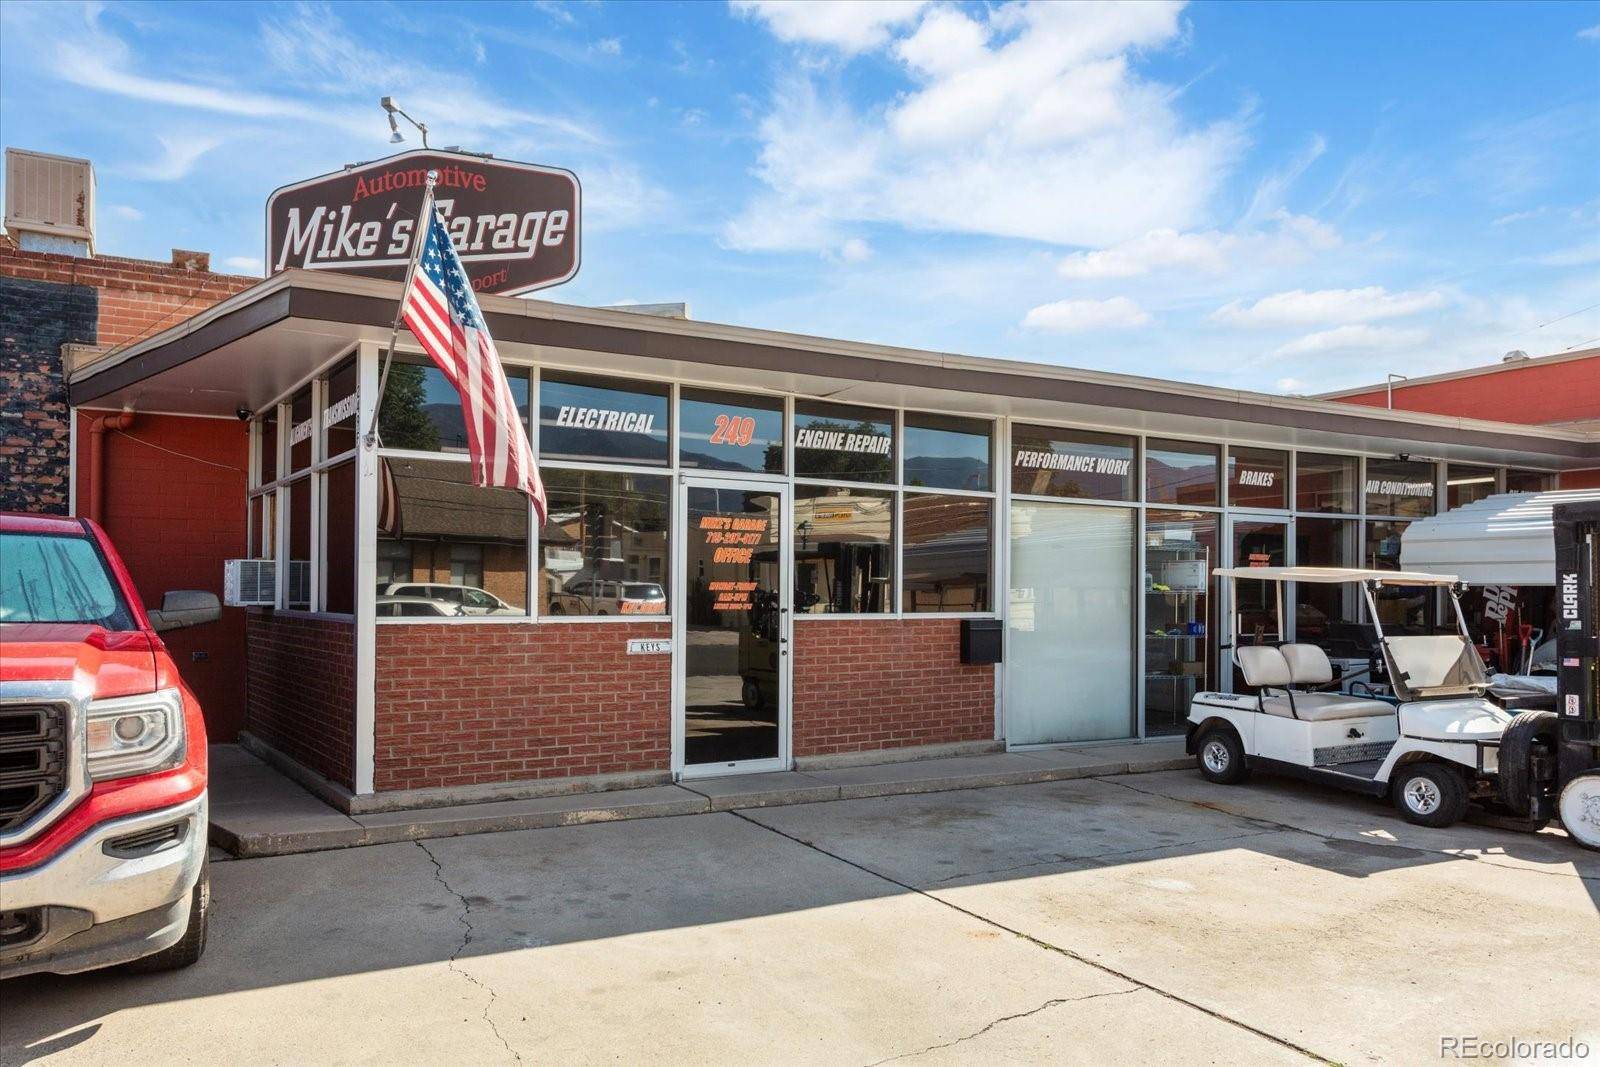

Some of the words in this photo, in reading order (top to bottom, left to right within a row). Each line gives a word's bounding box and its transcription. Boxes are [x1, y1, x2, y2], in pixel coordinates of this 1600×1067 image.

[275, 202, 414, 270] Mike's
[472, 269, 508, 291] port
[556, 406, 655, 433] ELECTRICAL
[709, 414, 756, 447] 249
[795, 428, 847, 450] ENGINE
[846, 433, 892, 454] REPAIR
[1015, 450, 1097, 474] PERFORMANCE
[1097, 457, 1130, 476] WORK
[1239, 470, 1274, 487] BRAKES
[1366, 480, 1380, 494] AIR
[1380, 481, 1434, 497] CONDITIONING
[713, 547, 754, 563] OFFICE
[1563, 573, 1578, 619] CLARK
[640, 643, 661, 652] KEYS
